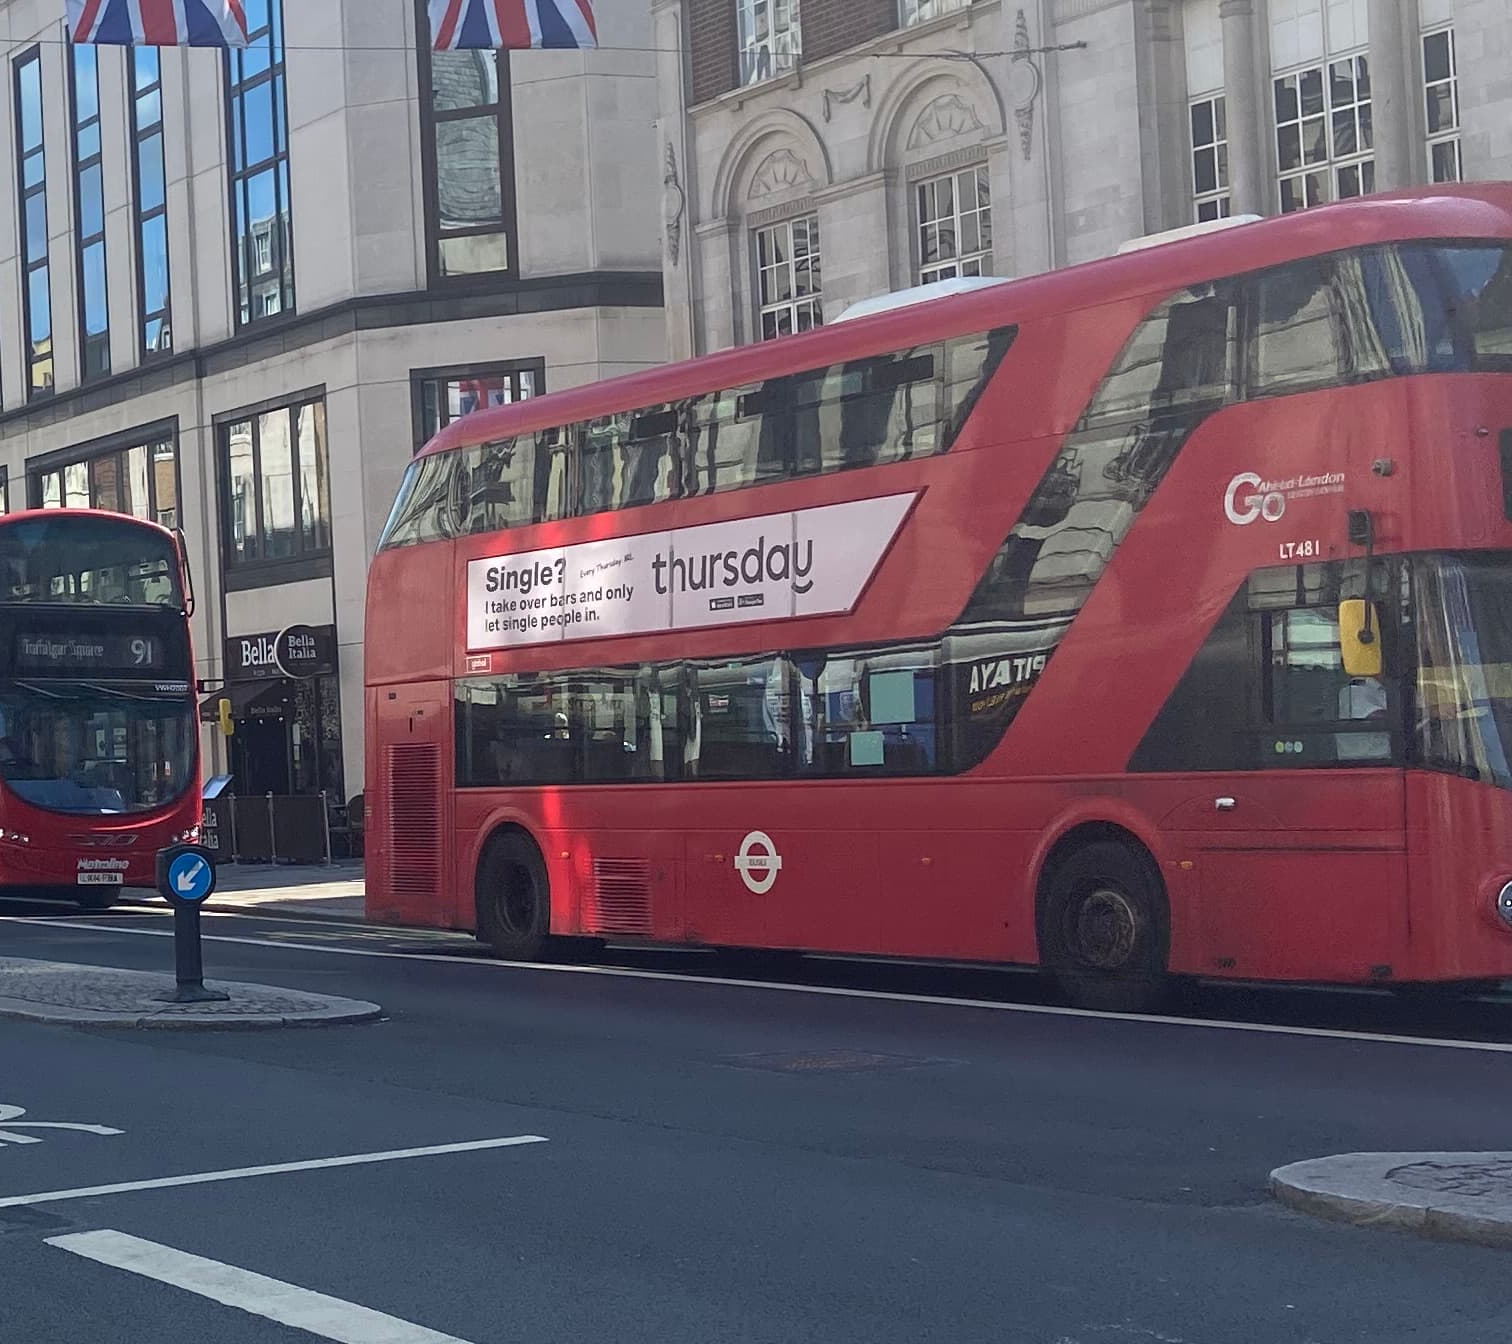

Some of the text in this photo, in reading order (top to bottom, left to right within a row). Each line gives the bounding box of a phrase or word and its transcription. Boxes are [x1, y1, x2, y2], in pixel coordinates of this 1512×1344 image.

[1279, 540, 1320, 559] LT481
[486, 558, 566, 594] Single?
[652, 536, 814, 594] thursday
[485, 584, 634, 614] I take over bars and only
[485, 607, 600, 632] let single people in.
[71, 640, 104, 660] Square
[131, 640, 152, 664] 91
[241, 638, 275, 666] Bella
[288, 635, 315, 647] Bella
[288, 647, 316, 659] Italia
[202, 807, 217, 827] ella
